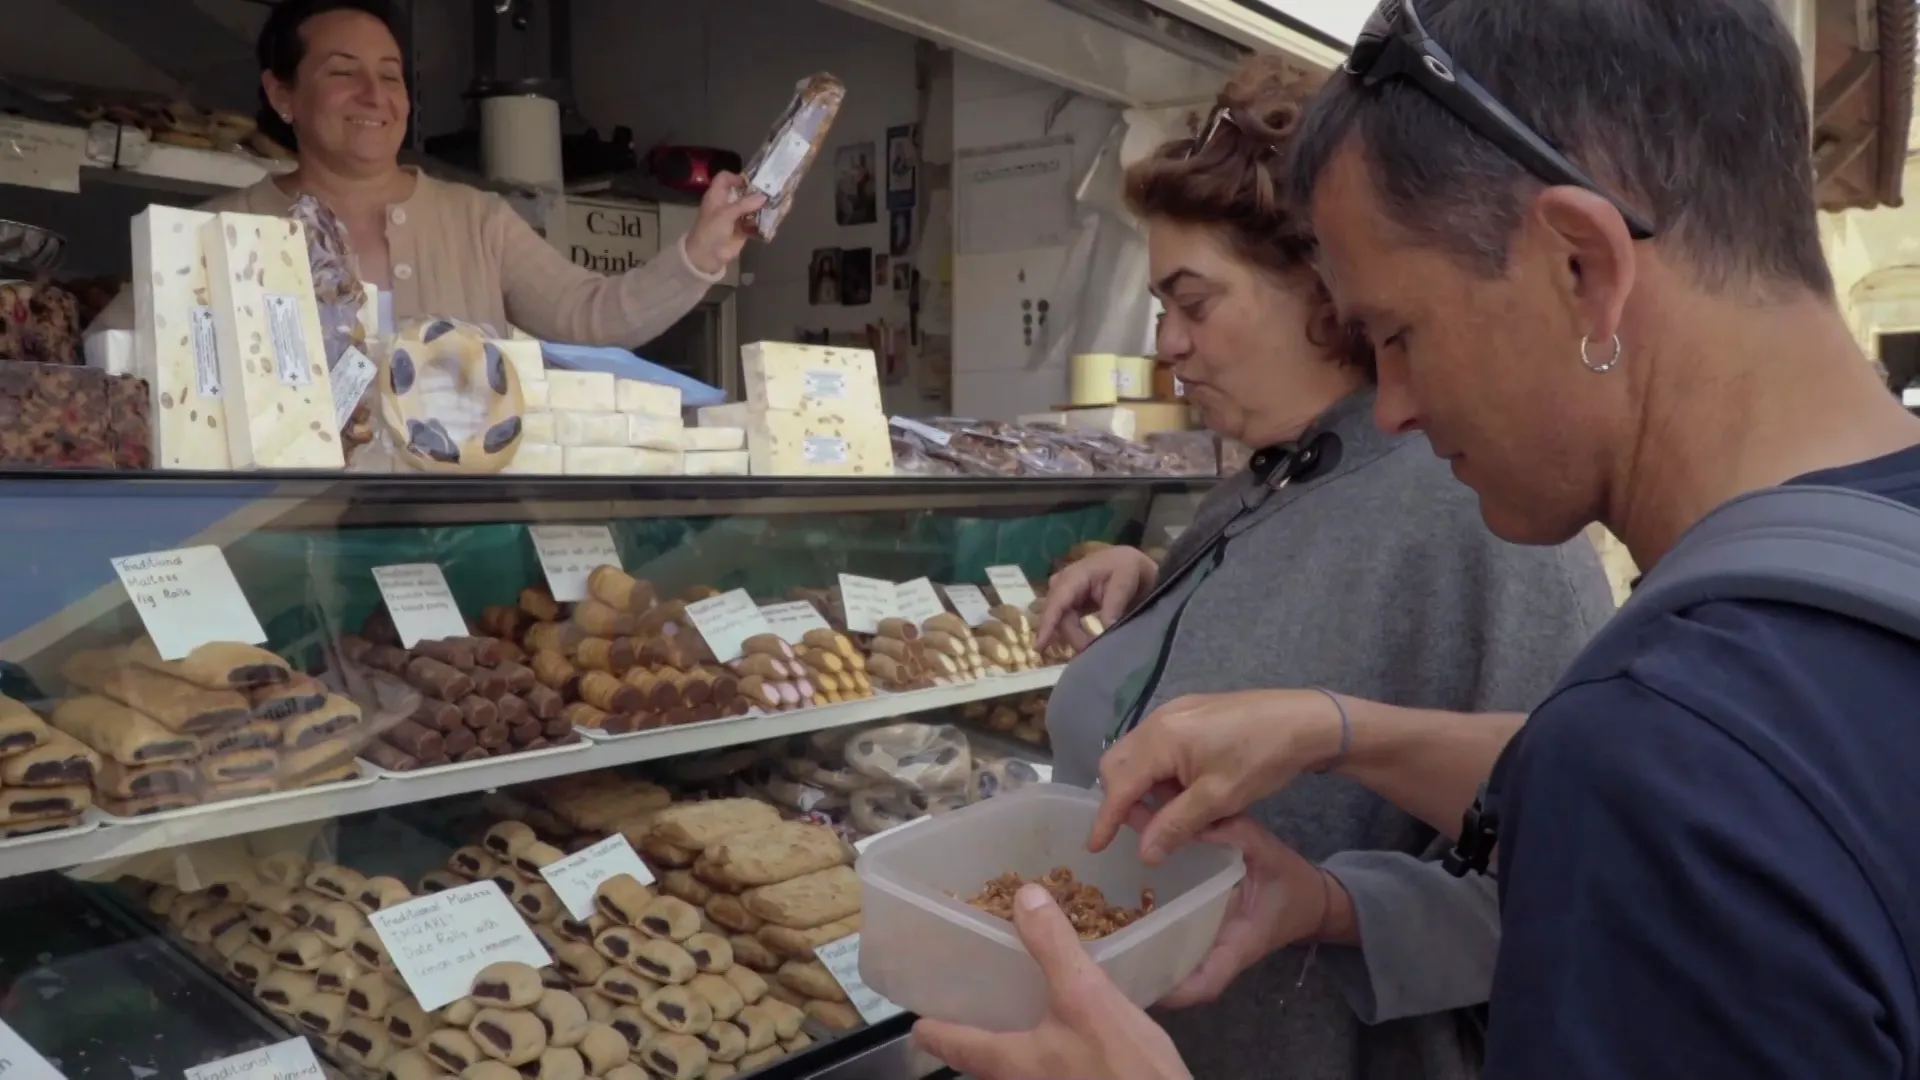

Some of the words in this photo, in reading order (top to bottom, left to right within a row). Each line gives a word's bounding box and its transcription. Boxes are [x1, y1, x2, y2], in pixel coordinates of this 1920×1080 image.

[586, 211, 642, 238] Cold
[570, 244, 646, 273] Drink
[116, 556, 183, 572] Traditional
[190, 1052, 273, 1080] Traditional
